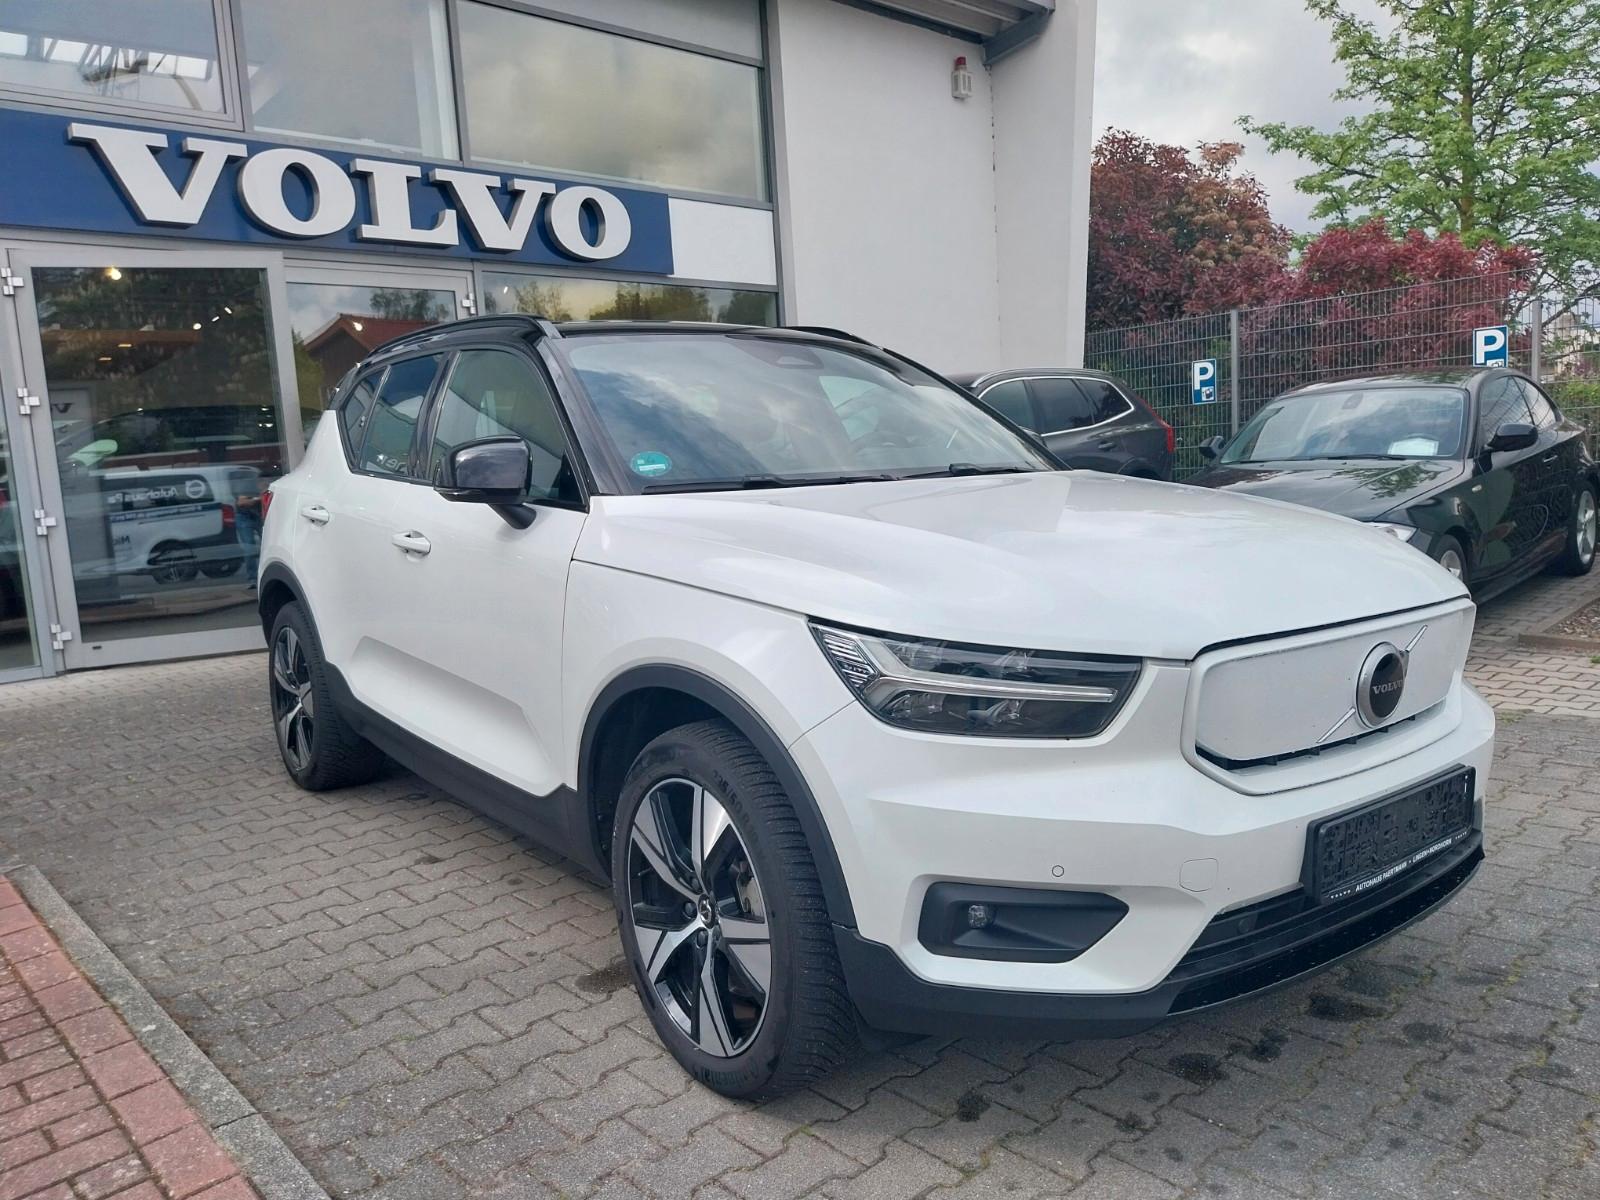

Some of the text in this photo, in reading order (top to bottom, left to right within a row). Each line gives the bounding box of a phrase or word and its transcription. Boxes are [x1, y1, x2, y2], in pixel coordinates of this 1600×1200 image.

[68, 122, 632, 262] VOLVO
[1476, 329, 1505, 364] P
[1193, 362, 1214, 390] P
[1355, 874, 1382, 892] AUTOHAUS
